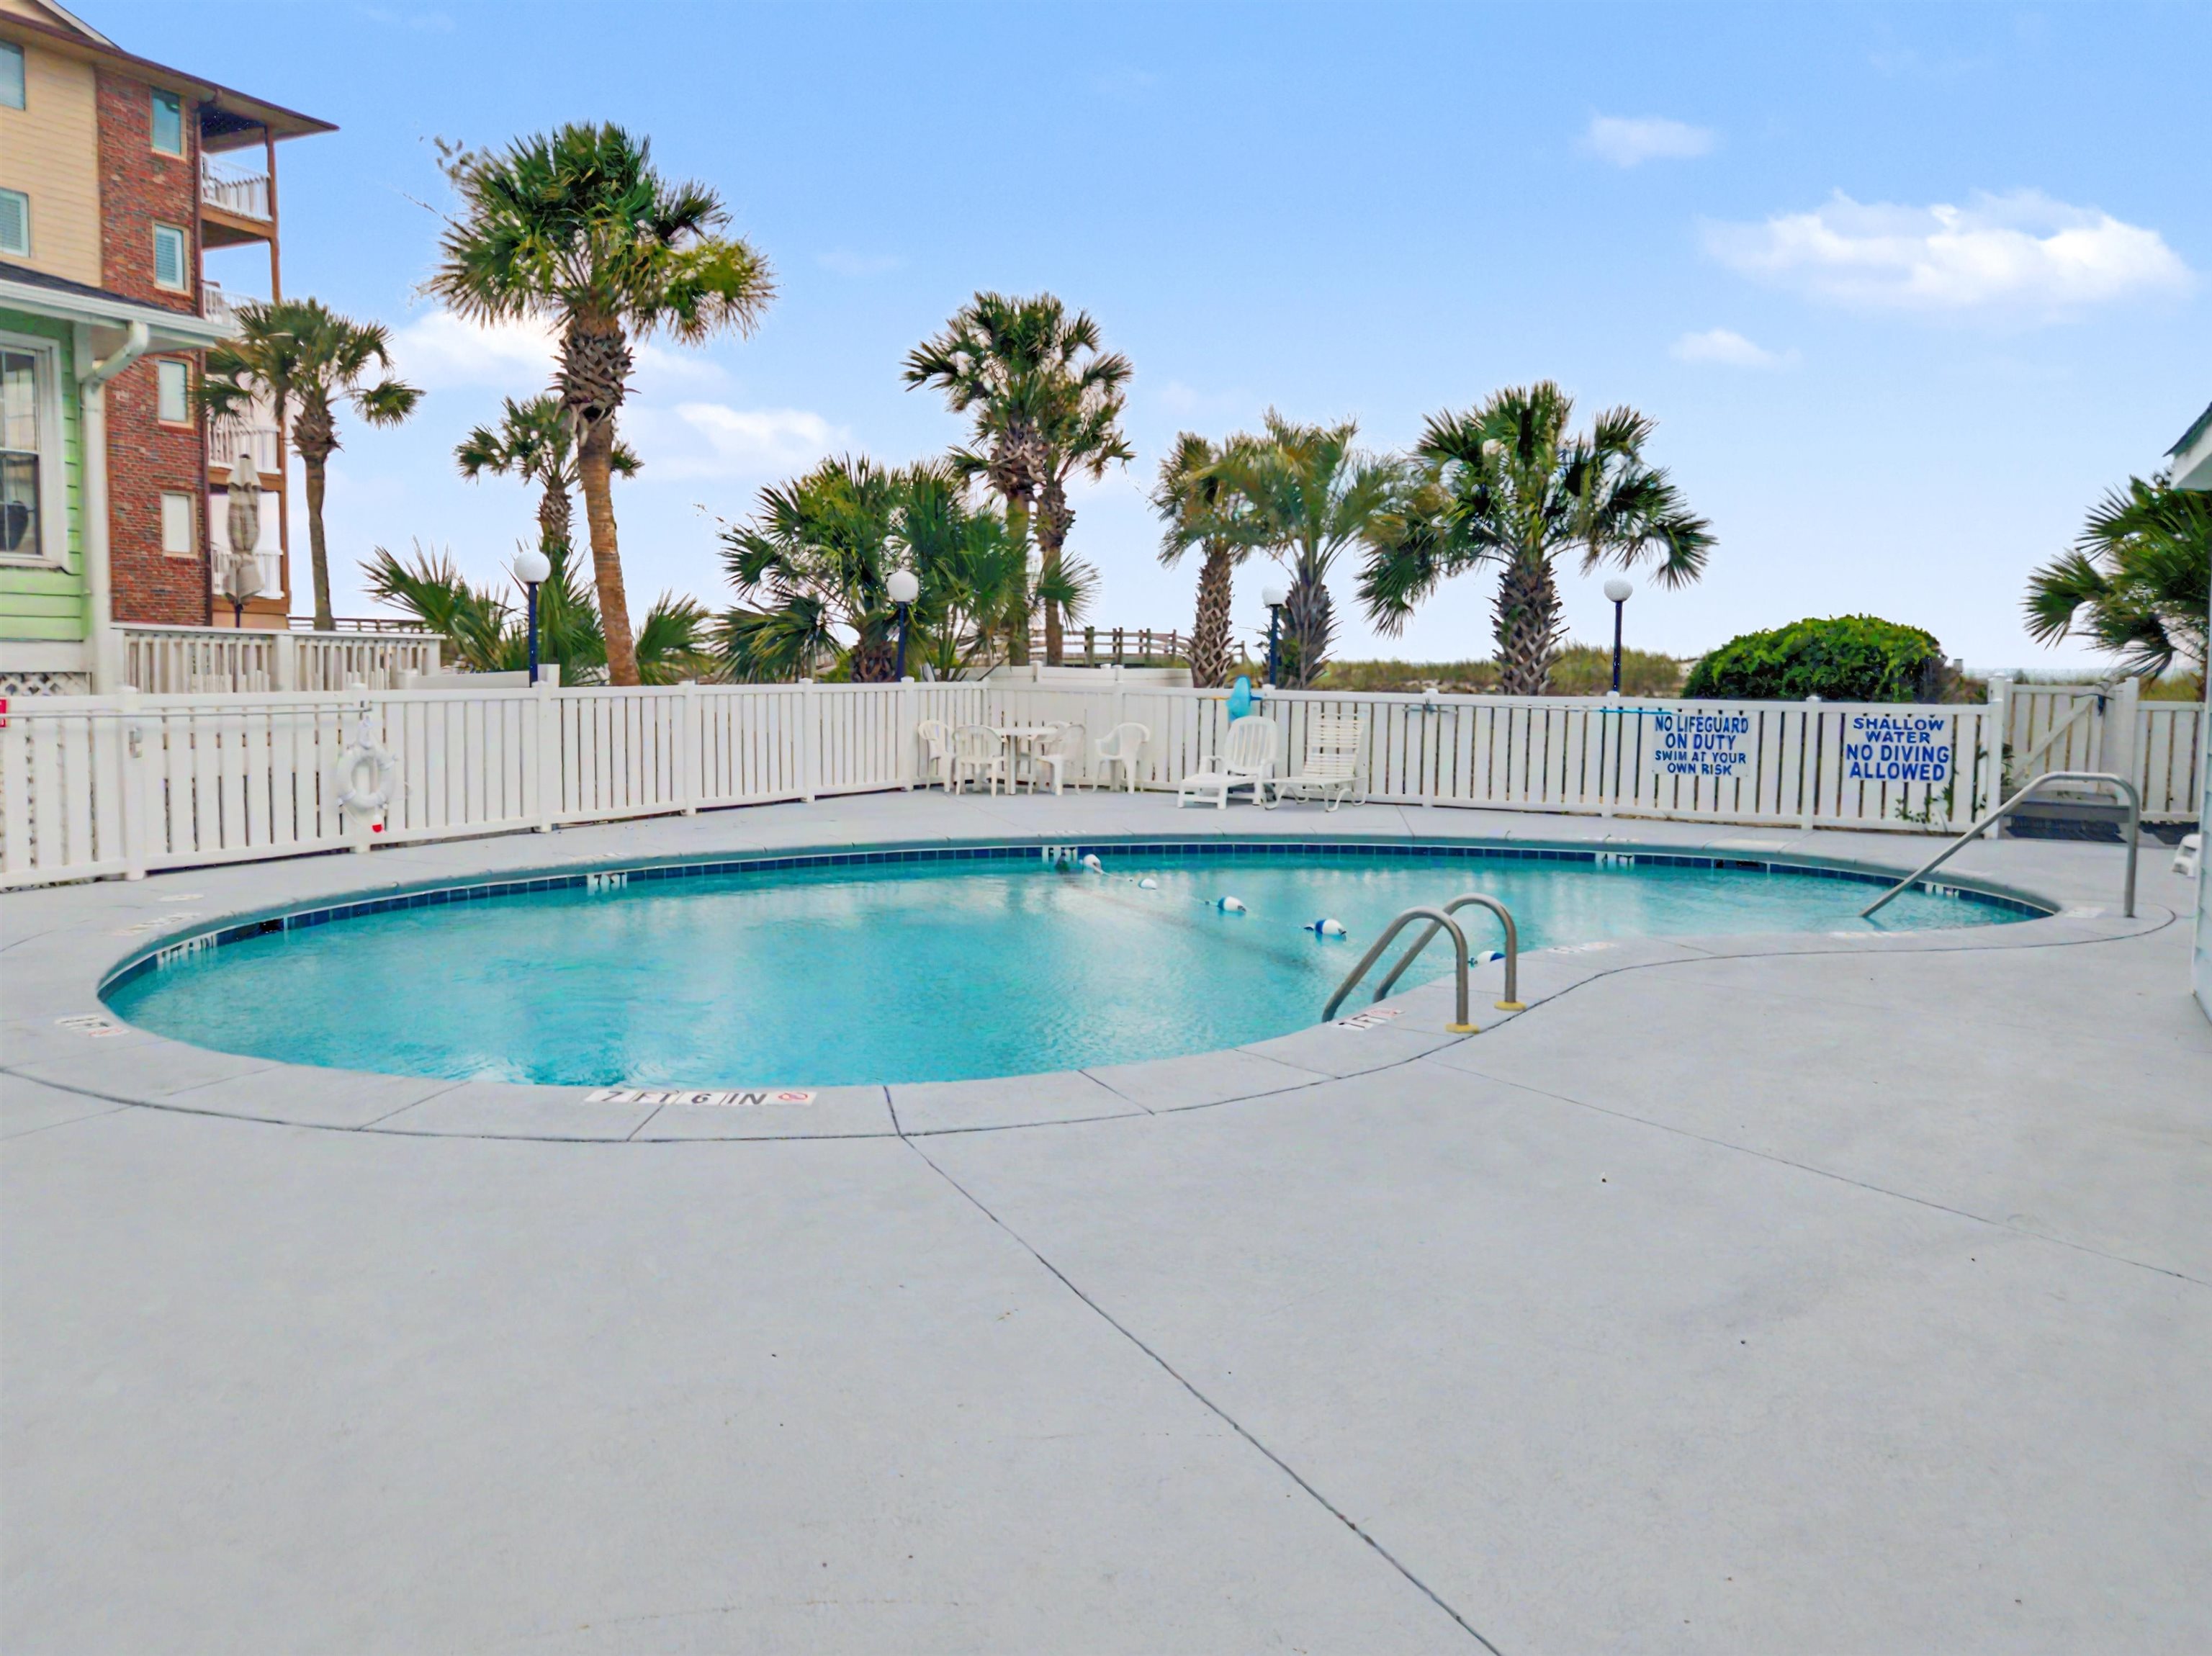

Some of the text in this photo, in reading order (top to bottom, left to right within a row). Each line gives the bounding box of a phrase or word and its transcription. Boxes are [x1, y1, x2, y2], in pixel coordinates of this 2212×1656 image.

[1655, 716, 1748, 734] NO LIFEGUARD
[1853, 718, 1944, 731] SHALLOW
[1665, 733, 1737, 750] ON DUTY
[1866, 731, 1930, 744] WATER
[1655, 750, 1746, 764] SWIM AT YOUR
[1847, 744, 1949, 763] NO DIVING
[1668, 762, 1732, 775] OWN RISK
[1850, 762, 1944, 781] ALLOWED
[691, 1093, 711, 1104] 6
